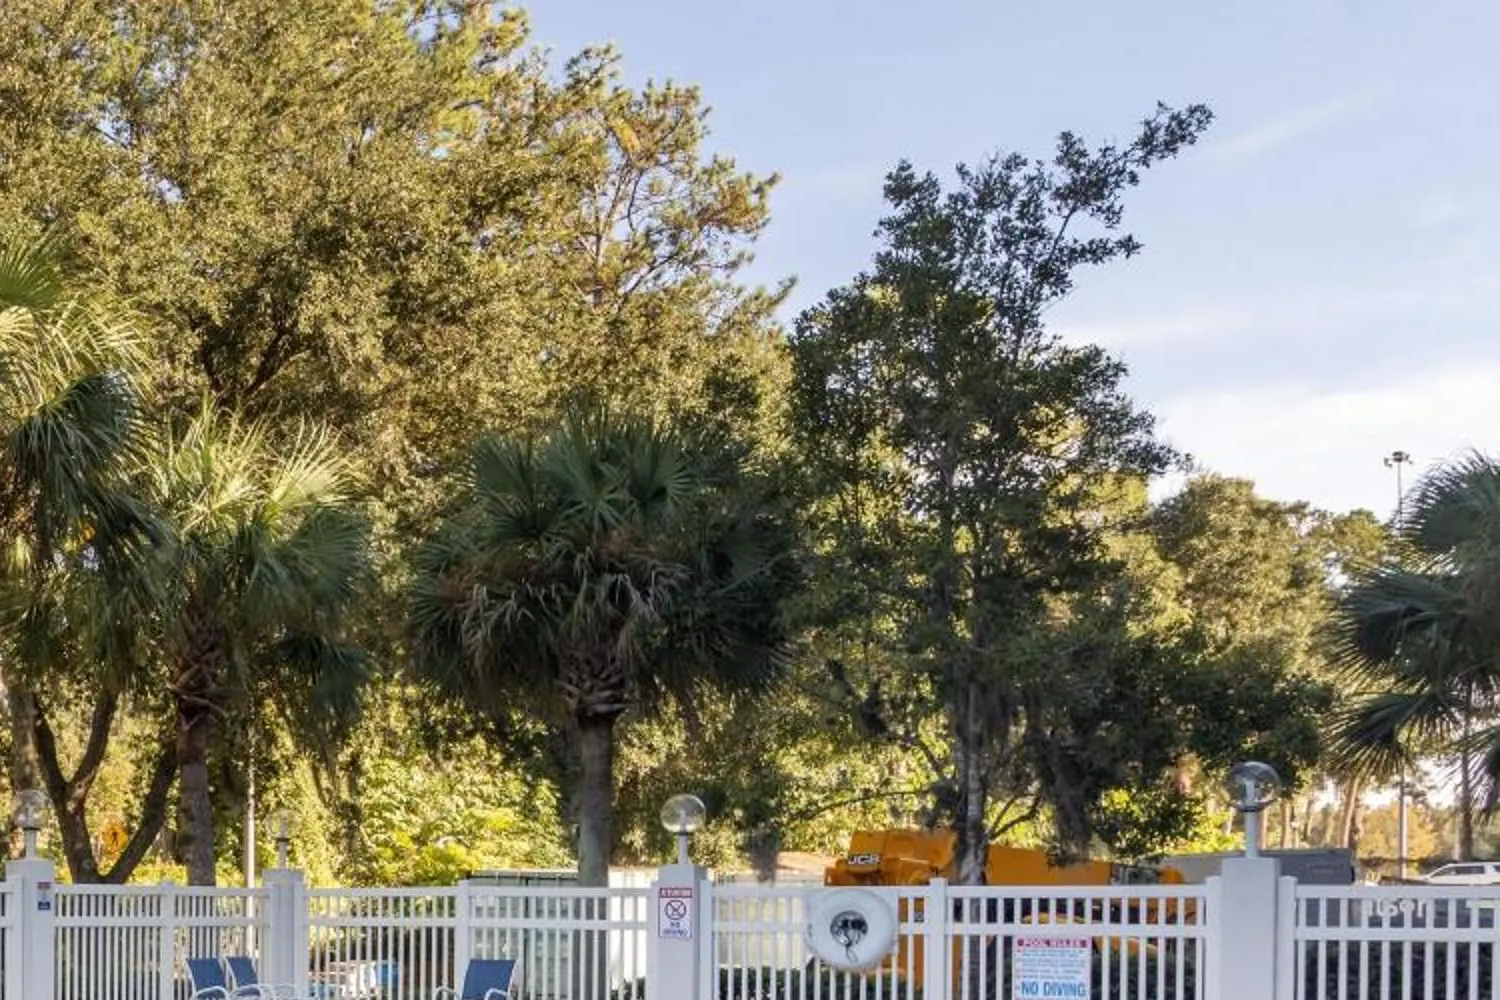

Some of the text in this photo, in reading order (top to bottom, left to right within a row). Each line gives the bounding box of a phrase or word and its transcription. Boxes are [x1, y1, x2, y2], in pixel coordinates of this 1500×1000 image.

[848, 854, 881, 865] JCB
[1021, 981, 1087, 997] NO DIVING
